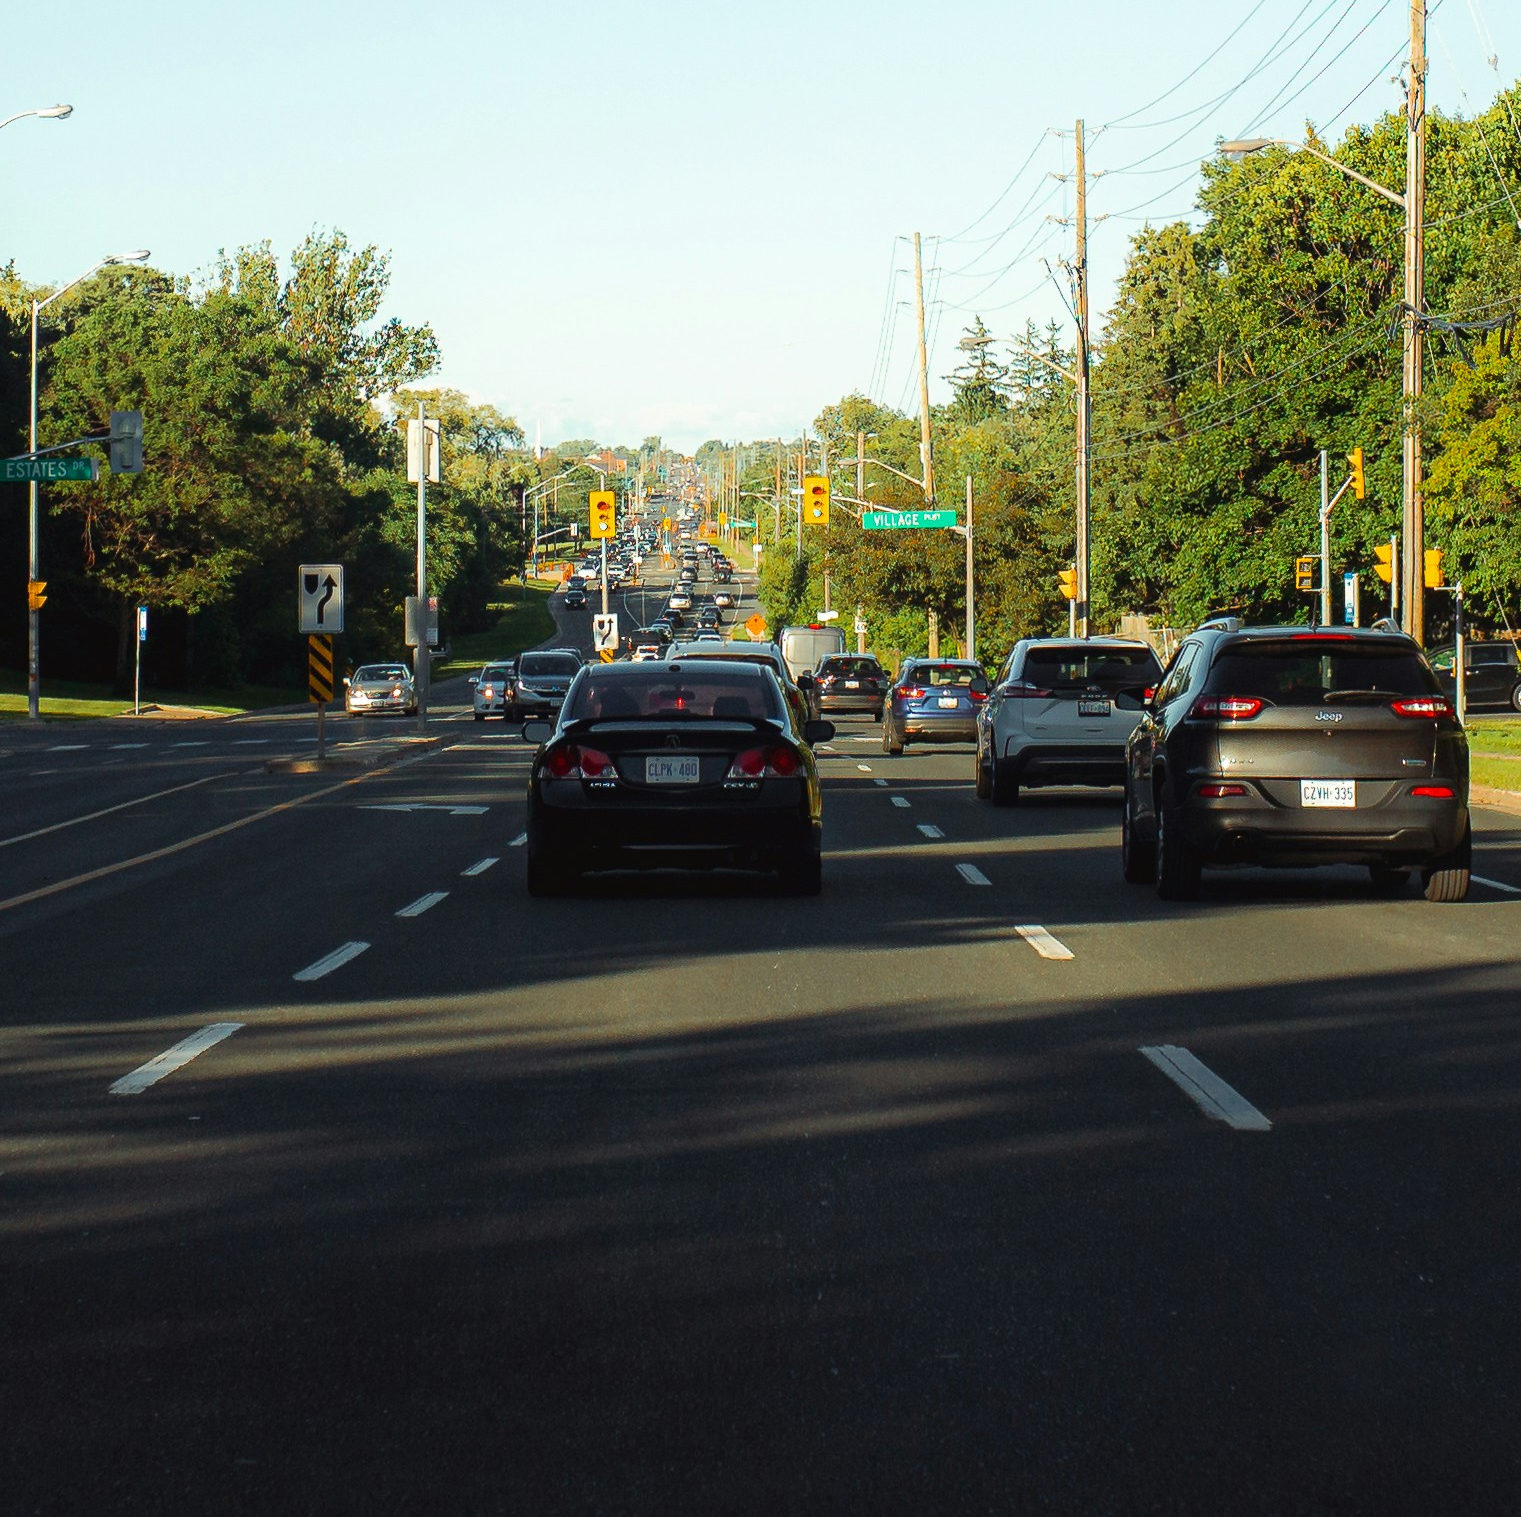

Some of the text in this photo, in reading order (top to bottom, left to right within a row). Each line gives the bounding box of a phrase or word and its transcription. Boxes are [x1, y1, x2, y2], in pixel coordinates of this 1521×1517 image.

[6, 461, 67, 478] ESTATES
[72, 461, 85, 470] DR
[873, 513, 920, 526] VILLAGE
[1314, 710, 1344, 723] Jeep
[648, 762, 673, 777] CLPK
[1303, 786, 1353, 801] CZVH 335
